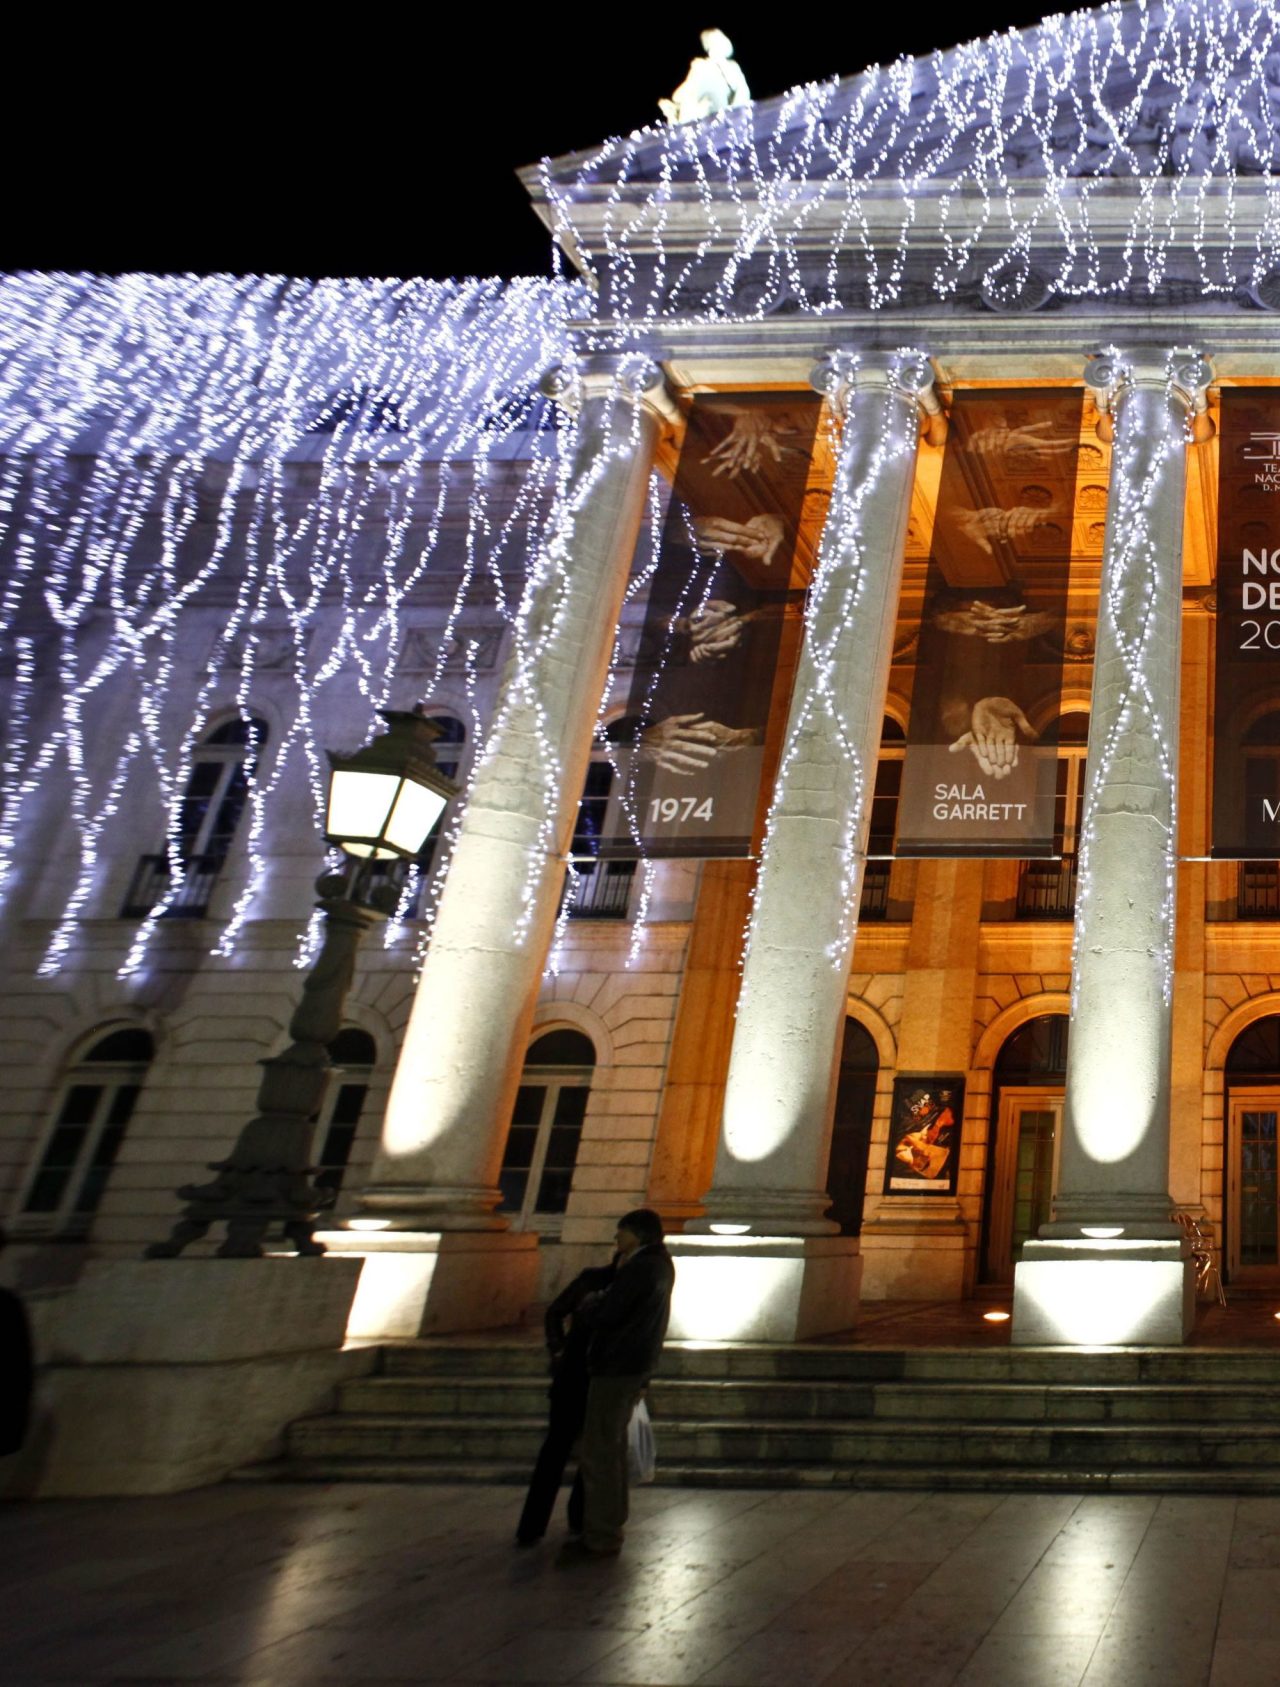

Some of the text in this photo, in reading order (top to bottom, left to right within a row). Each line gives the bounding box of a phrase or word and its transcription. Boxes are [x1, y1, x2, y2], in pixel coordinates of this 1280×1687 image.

[1263, 484, 1273, 492] D.
[934, 783, 986, 801] SALA
[650, 796, 714, 823] 1974
[932, 803, 1028, 821] GARRETT
